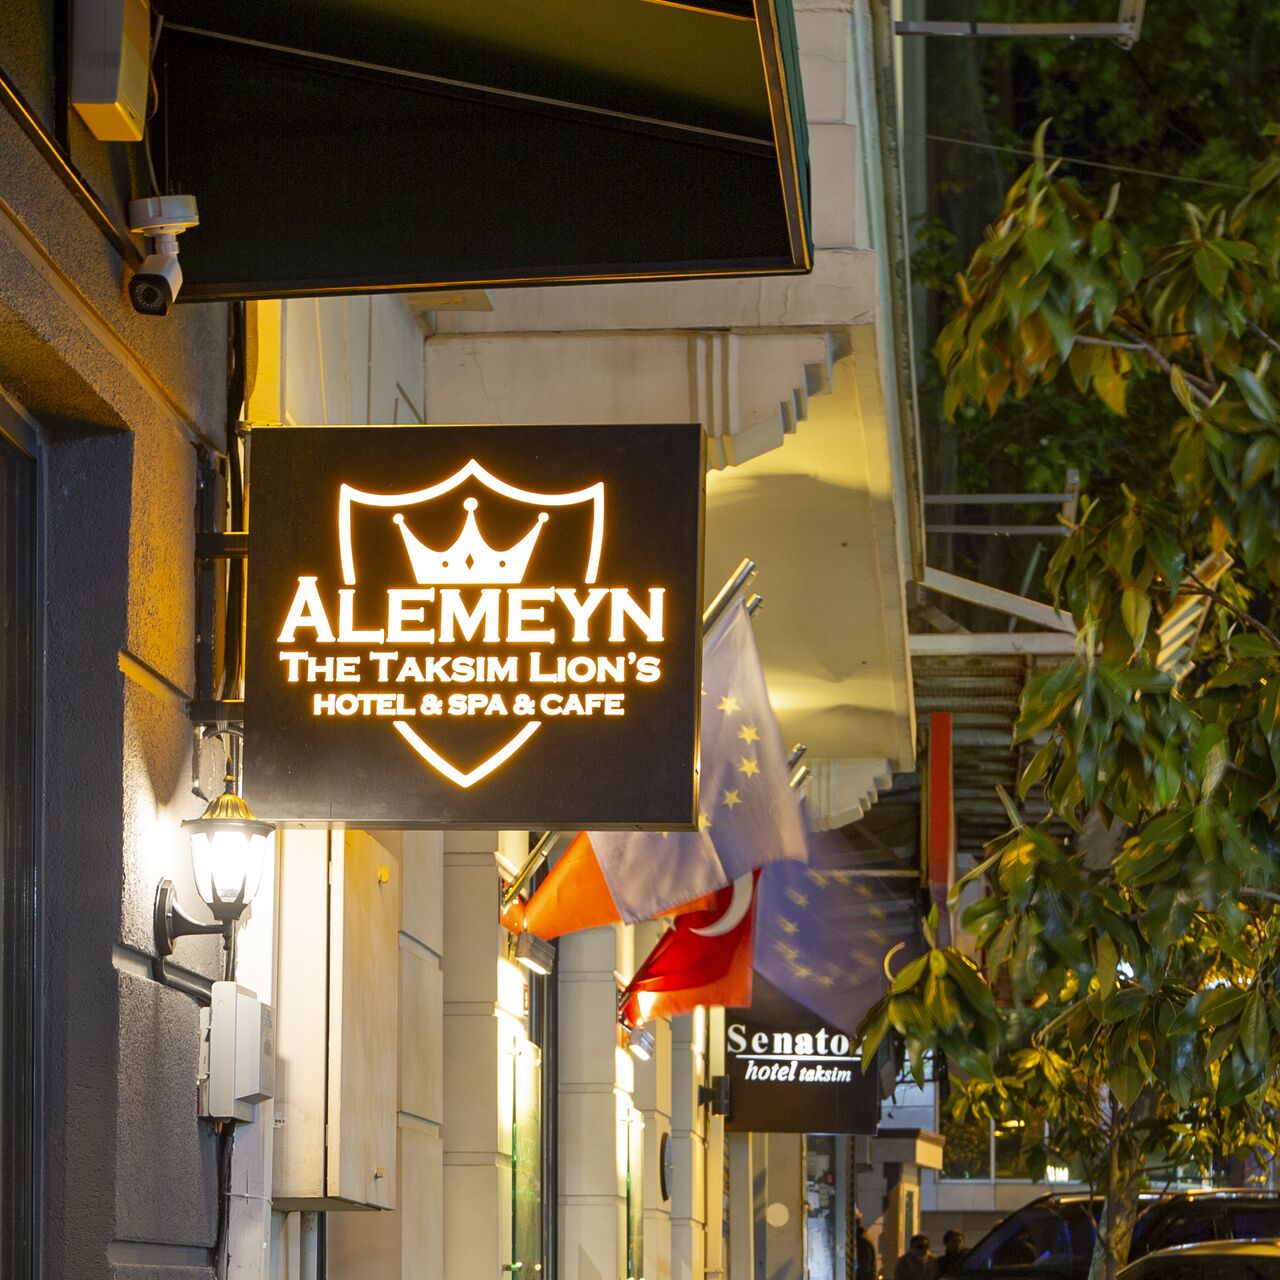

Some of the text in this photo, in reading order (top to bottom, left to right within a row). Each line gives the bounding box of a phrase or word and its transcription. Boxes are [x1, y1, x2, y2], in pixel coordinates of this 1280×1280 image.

[276, 576, 666, 644] ALEMEYN
[279, 651, 662, 684] THE TAKSIM LION'S
[312, 693, 625, 716] HOTEL & SPA & CAFE
[745, 1060, 852, 1083] hotel taksim
